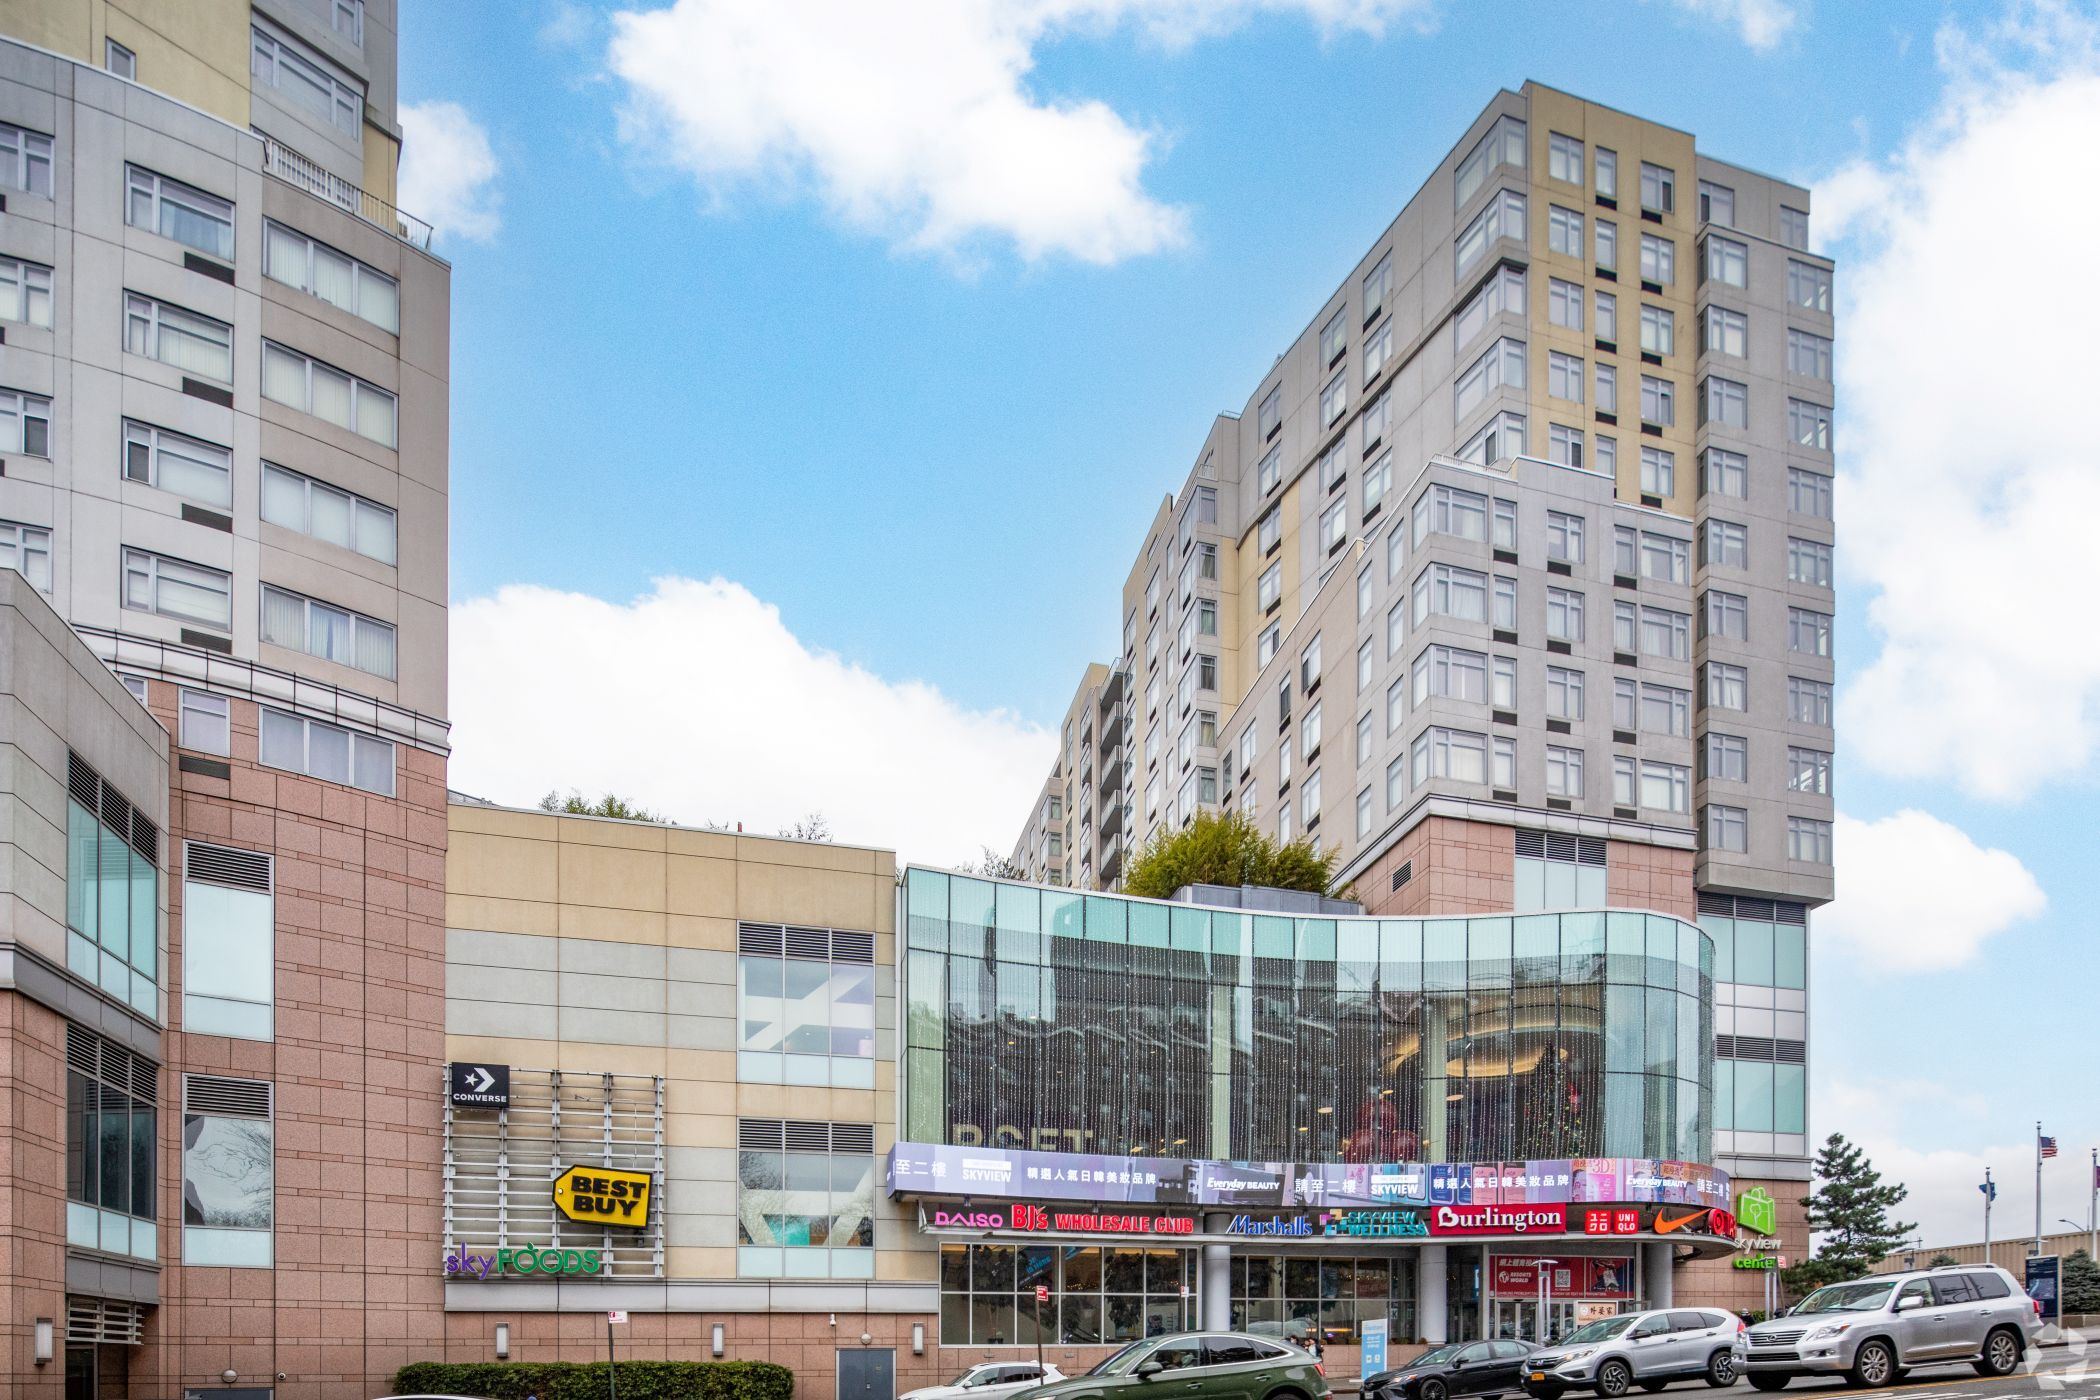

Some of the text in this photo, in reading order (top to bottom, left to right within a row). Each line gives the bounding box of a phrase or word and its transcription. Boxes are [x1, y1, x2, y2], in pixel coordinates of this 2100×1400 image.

[453, 1093, 507, 1103] CONVERSE
[962, 1169, 1012, 1182] SKYVIEW
[1625, 1175, 1688, 1188] Everyday BEAUTY
[571, 1175, 647, 1199] BEST
[1207, 1177, 1280, 1191] Everyday BEAUTY
[1371, 1184, 1418, 1195] SKYVIEW
[573, 1195, 639, 1217] BUY
[935, 1212, 1004, 1228] DAISO
[1011, 1204, 1194, 1233] BJ's WHOLESALE CLUB
[1347, 1211, 1417, 1224] SKYVIEW
[1438, 1206, 1562, 1232] Burlington
[1618, 1213, 1635, 1222] UNI
[1226, 1214, 1313, 1236] Marshalls
[1348, 1222, 1429, 1236] WELLNESS
[1618, 1222, 1635, 1233] QLO
[1733, 1252, 1777, 1269] cente
